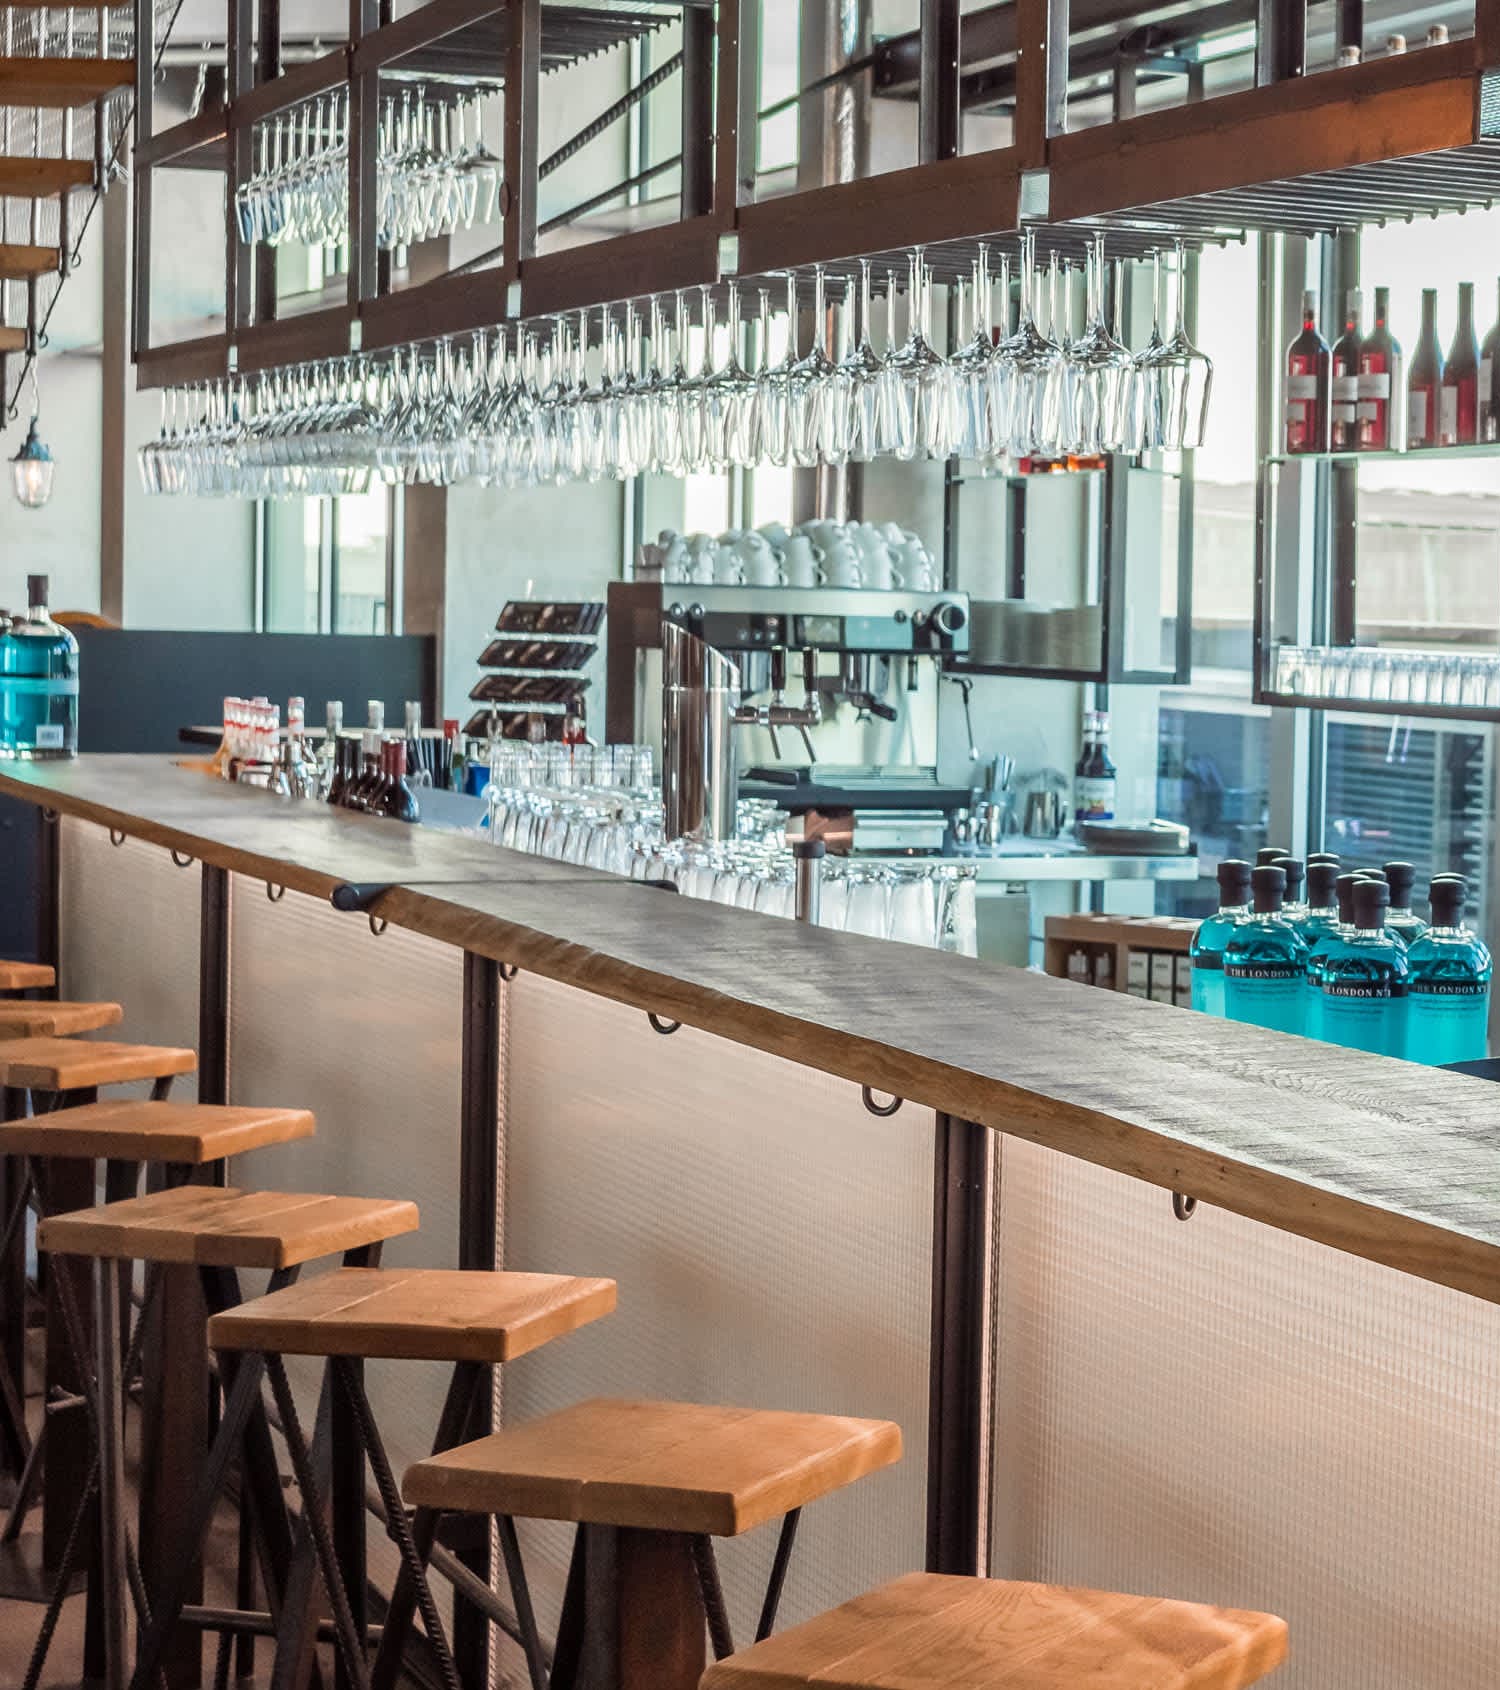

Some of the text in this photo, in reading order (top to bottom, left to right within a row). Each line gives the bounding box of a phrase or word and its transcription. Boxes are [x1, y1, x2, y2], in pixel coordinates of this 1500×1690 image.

[1231, 967, 1246, 977] THE
[1249, 969, 1291, 978] LONDON
[1331, 986, 1373, 997] LONDON
[1432, 984, 1475, 994] LONDON
